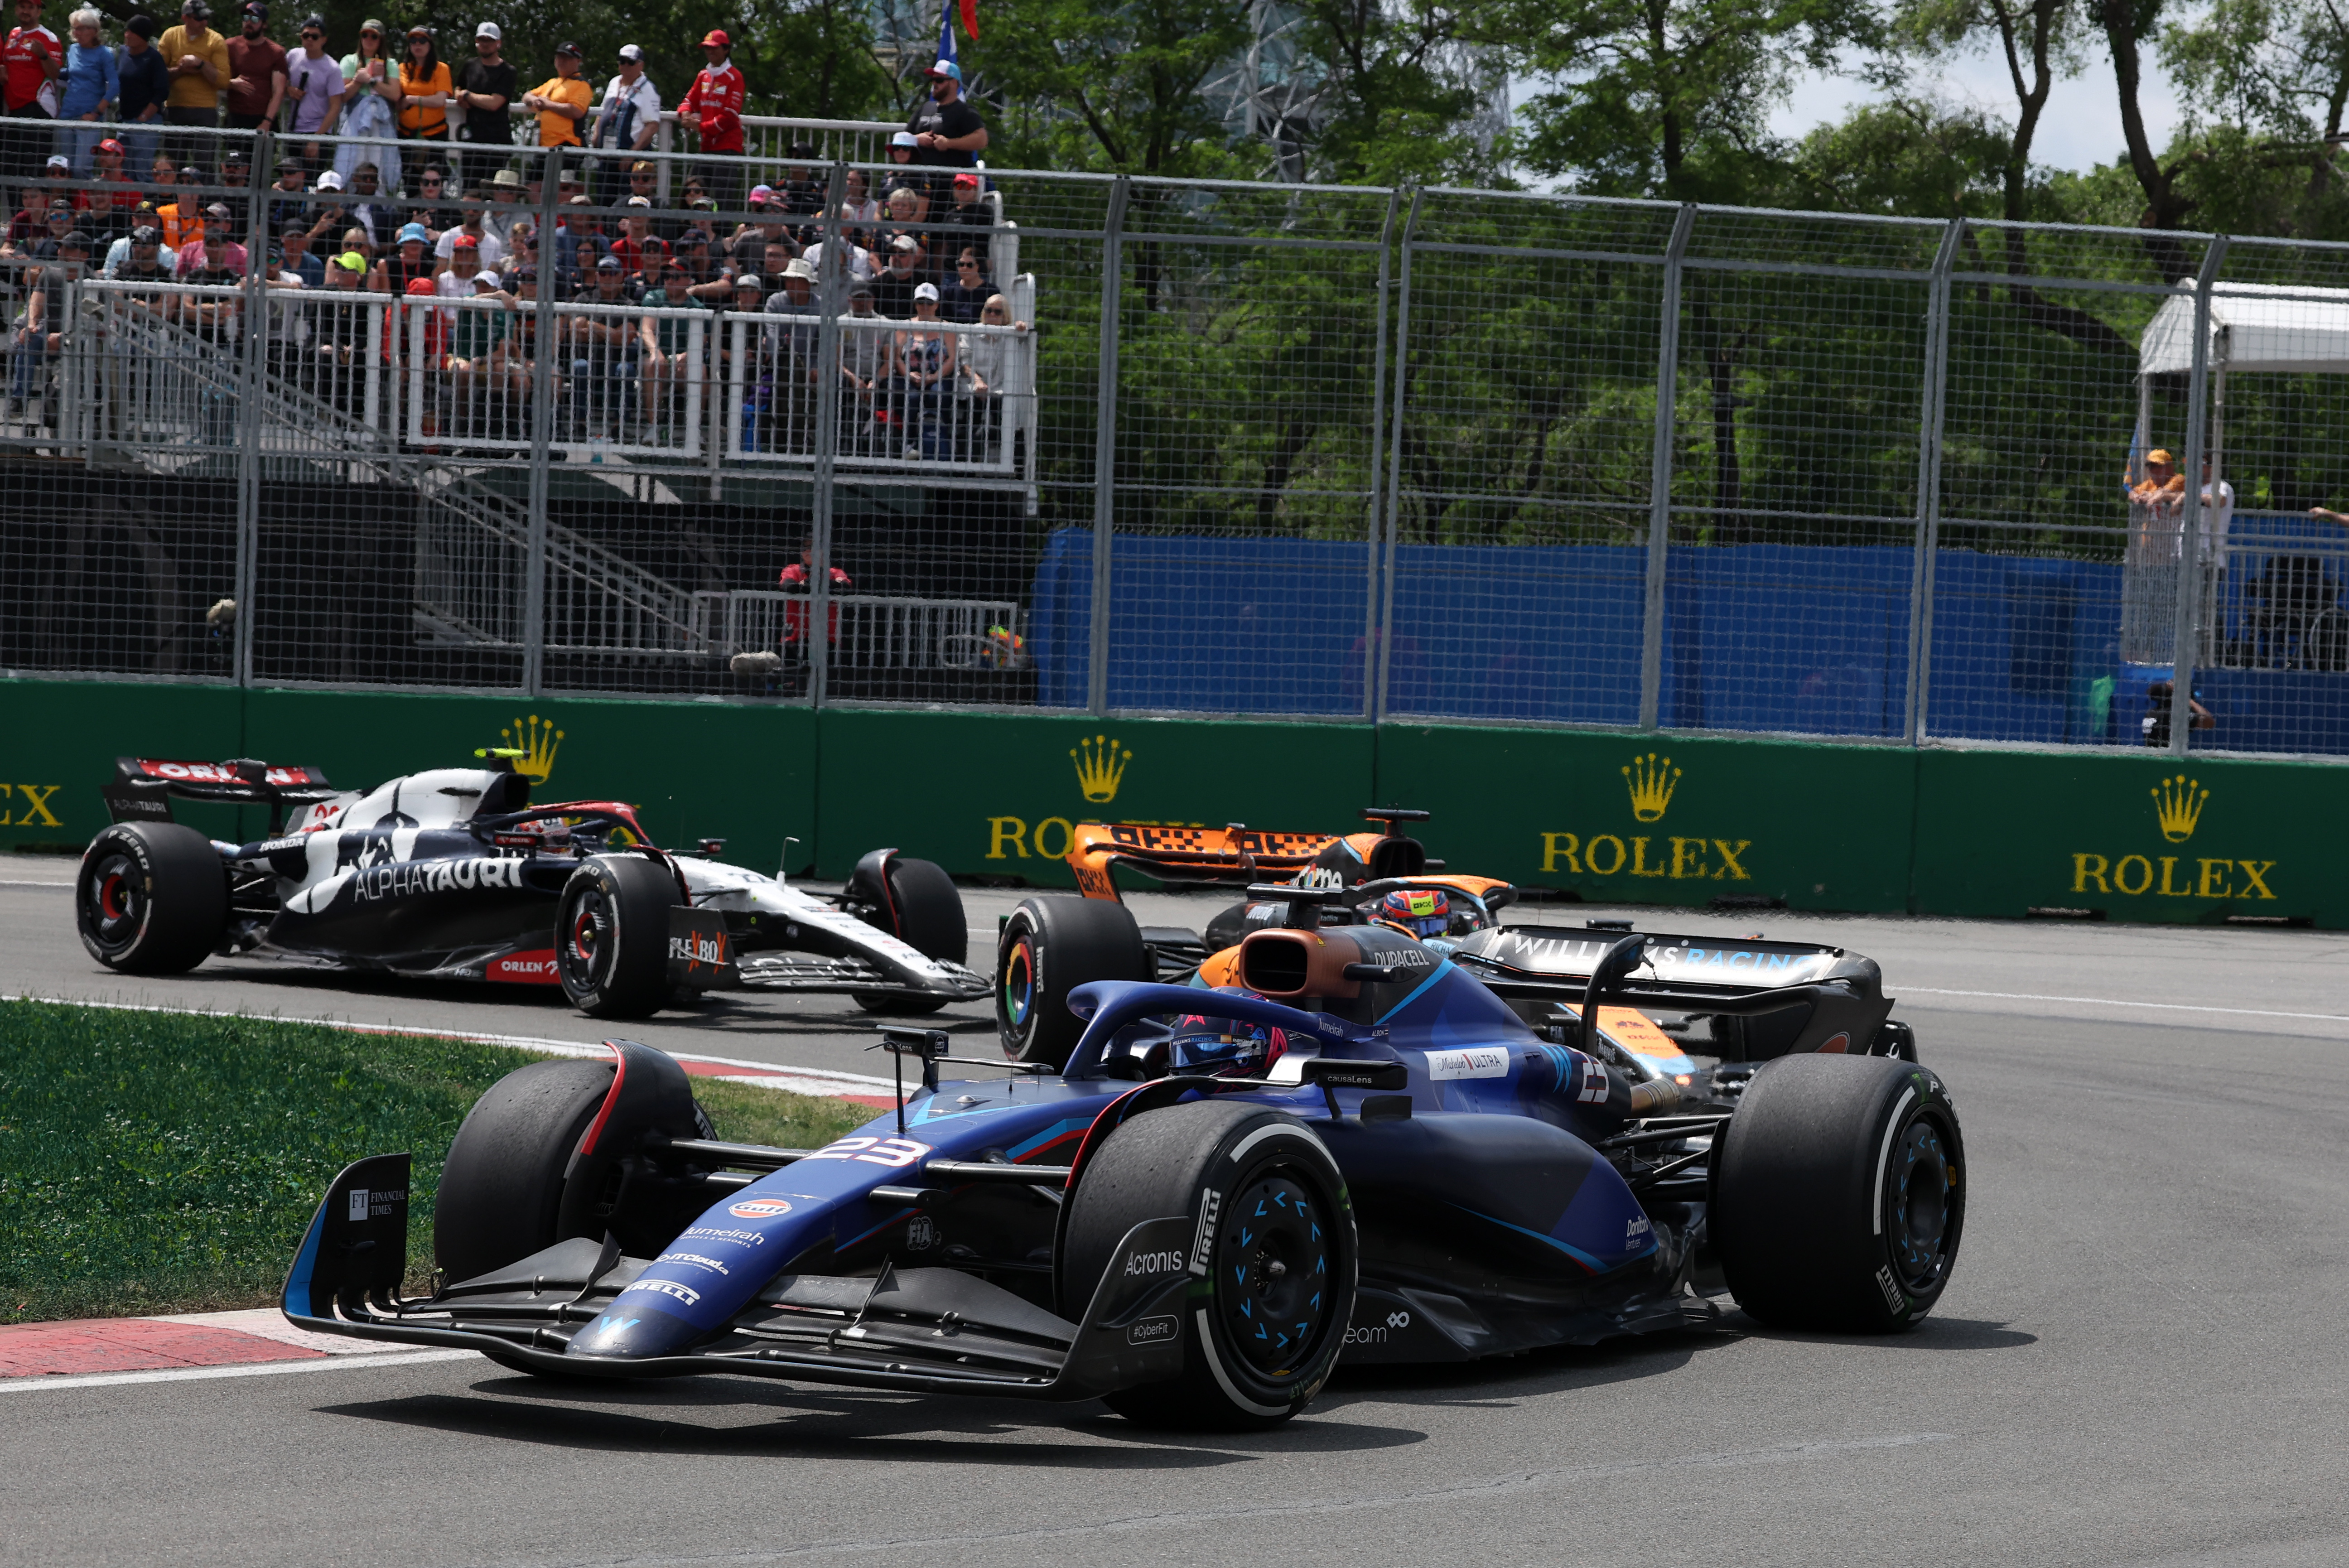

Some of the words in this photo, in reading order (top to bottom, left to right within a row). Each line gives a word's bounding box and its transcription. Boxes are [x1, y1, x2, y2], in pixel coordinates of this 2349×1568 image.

[159, 762, 292, 783] ORLN
[113, 799, 167, 813] ALPHATAURI
[258, 838, 304, 853] HONDA
[1539, 832, 1752, 880] ROLEX
[354, 857, 526, 903] ALPHATAURI
[2070, 853, 2278, 900] ROLEX
[501, 960, 543, 973] ORLEN
[1374, 950, 1430, 968] DURACELL
[1684, 948, 1812, 973] RACING
[1317, 1018, 1344, 1037] Jumeirah
[1436, 1057, 1466, 1071] Michelob
[1470, 1054, 1502, 1068] ULTRA
[1327, 1075, 1372, 1084] causaLens
[801, 1137, 934, 1168] 23
[352, 1193, 367, 1209] FT
[371, 1189, 405, 1202] FINANCIAL
[370, 1204, 392, 1216] TIMES
[734, 1204, 788, 1214] Gulf
[678, 1226, 765, 1245] Jumeirah
[1188, 1187, 1221, 1277] PIRELLI
[717, 1237, 752, 1248] RESORTS
[1625, 1238, 1641, 1250] Ventures
[669, 1253, 729, 1275] ITCloud.ca
[693, 1263, 714, 1273] Company
[1124, 1250, 1182, 1277] Acronis
[1876, 1264, 1905, 1316] PIRELLI
[1134, 1322, 1168, 1339] #CyberFit
[1345, 1327, 1387, 1343] eam
